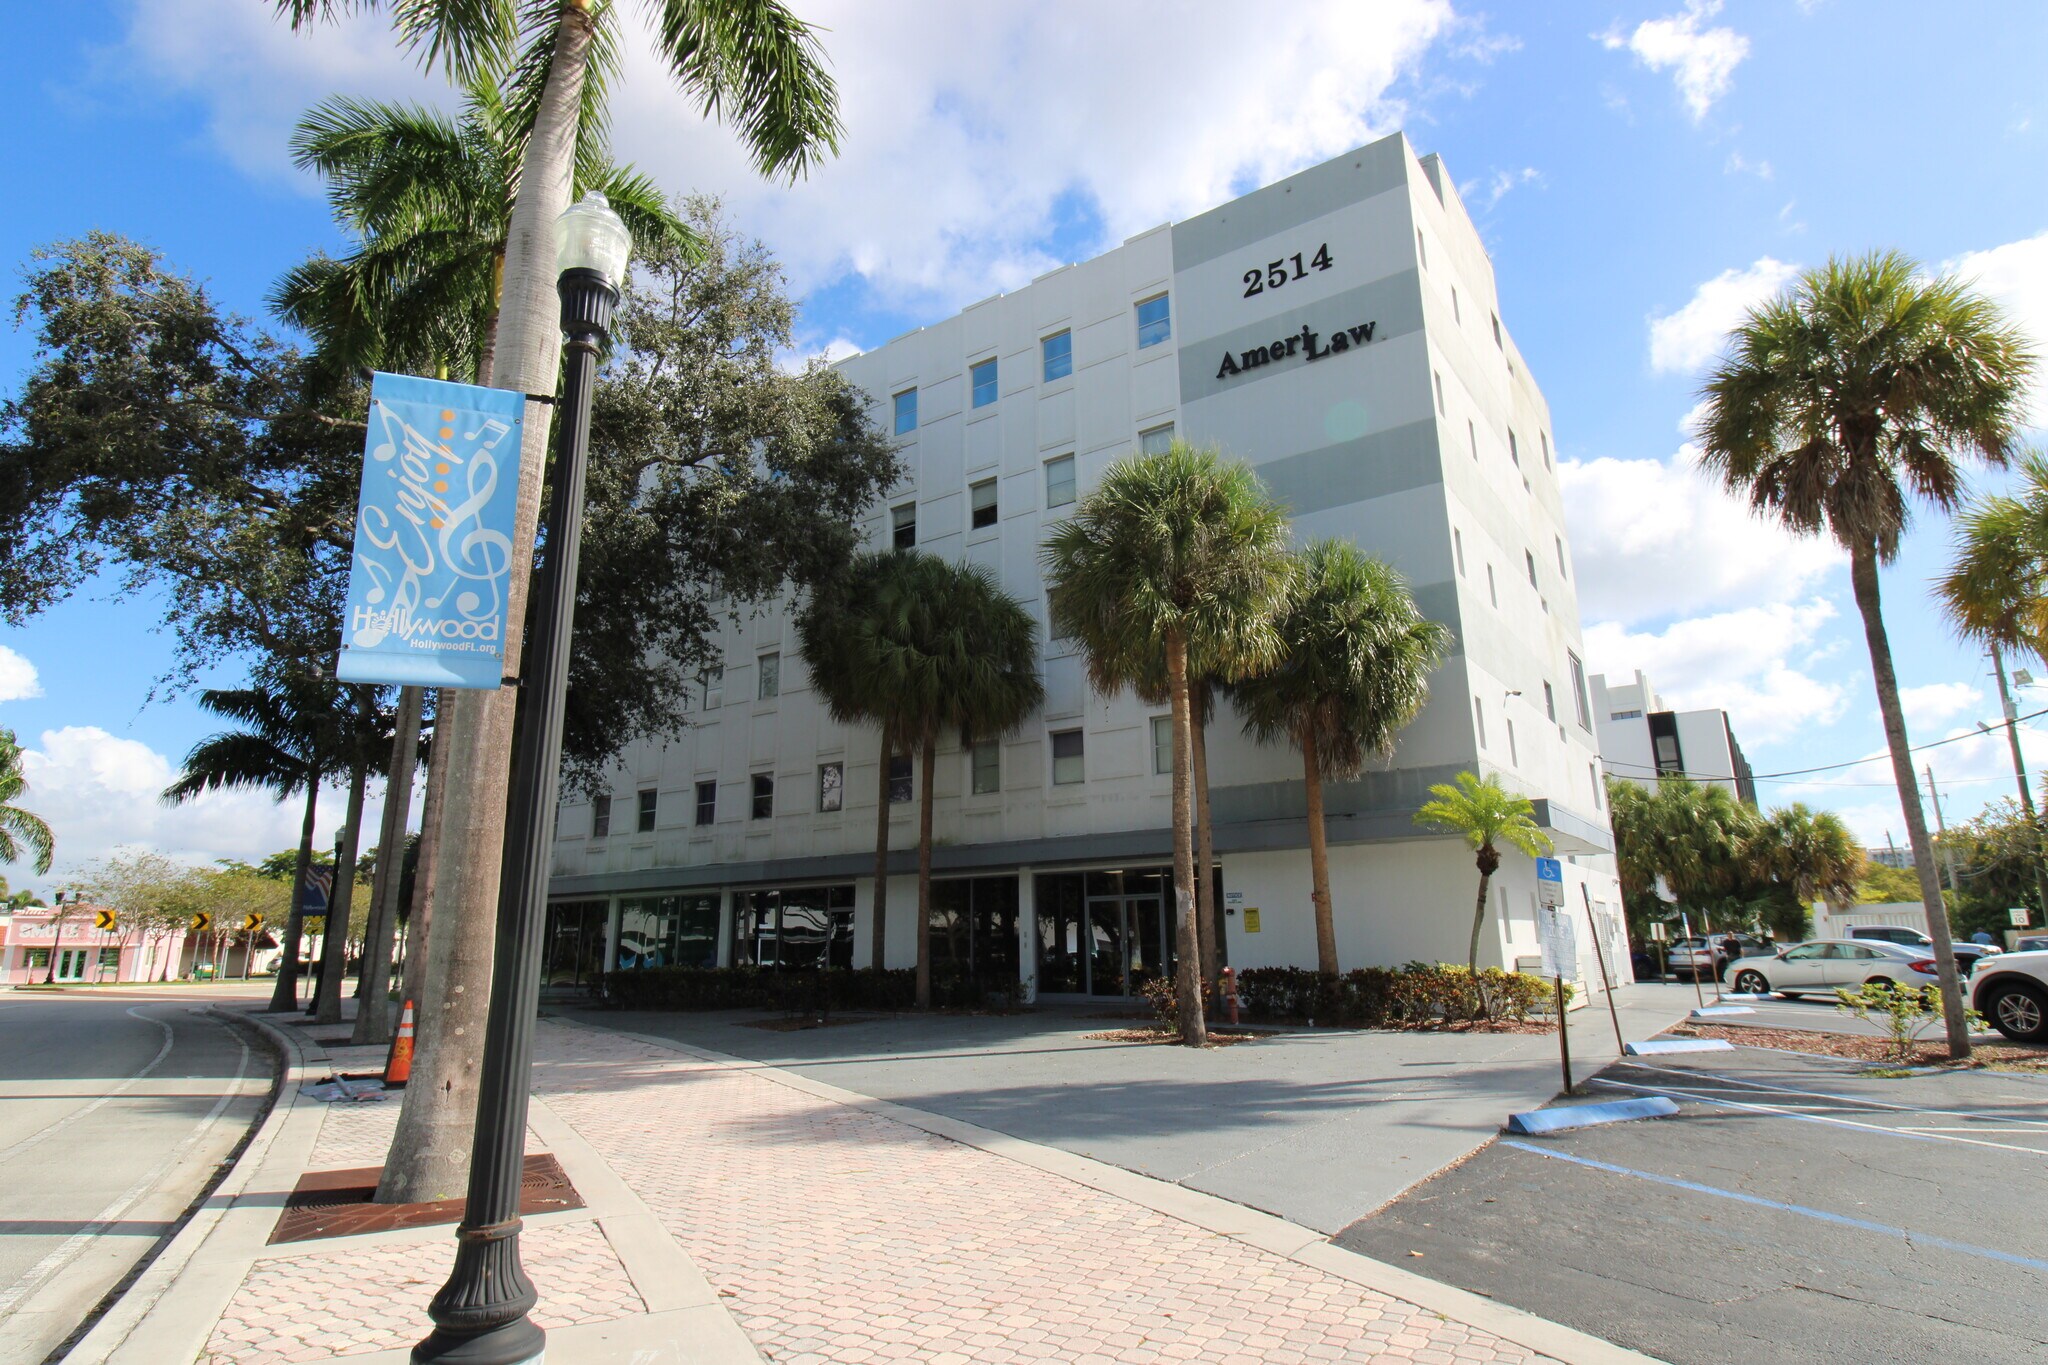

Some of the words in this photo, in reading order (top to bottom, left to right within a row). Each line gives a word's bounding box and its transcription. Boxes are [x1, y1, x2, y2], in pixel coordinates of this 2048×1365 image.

[1243, 242, 1333, 298] 2514
[361, 422, 464, 576] Enjoy
[352, 605, 500, 641] Hollywood
[410, 639, 497, 655] HollywoodFL.org
